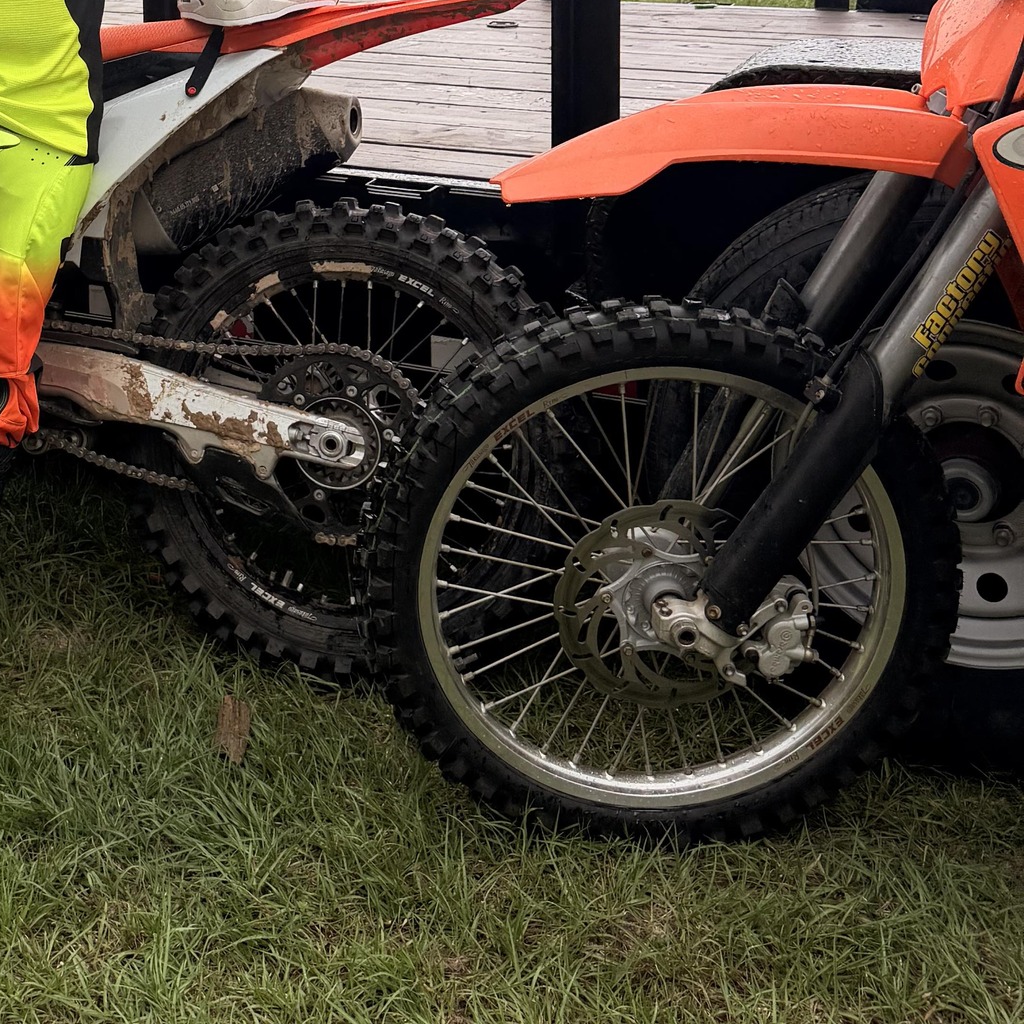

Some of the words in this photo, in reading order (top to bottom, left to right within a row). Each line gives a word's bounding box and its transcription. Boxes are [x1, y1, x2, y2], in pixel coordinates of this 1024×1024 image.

[397, 274, 435, 298] EXCEL
[911, 229, 1003, 350] Factory
[494, 409, 535, 442] EXCEL
[250, 582, 286, 609] EXCEL
[806, 715, 844, 750] EXCEL
